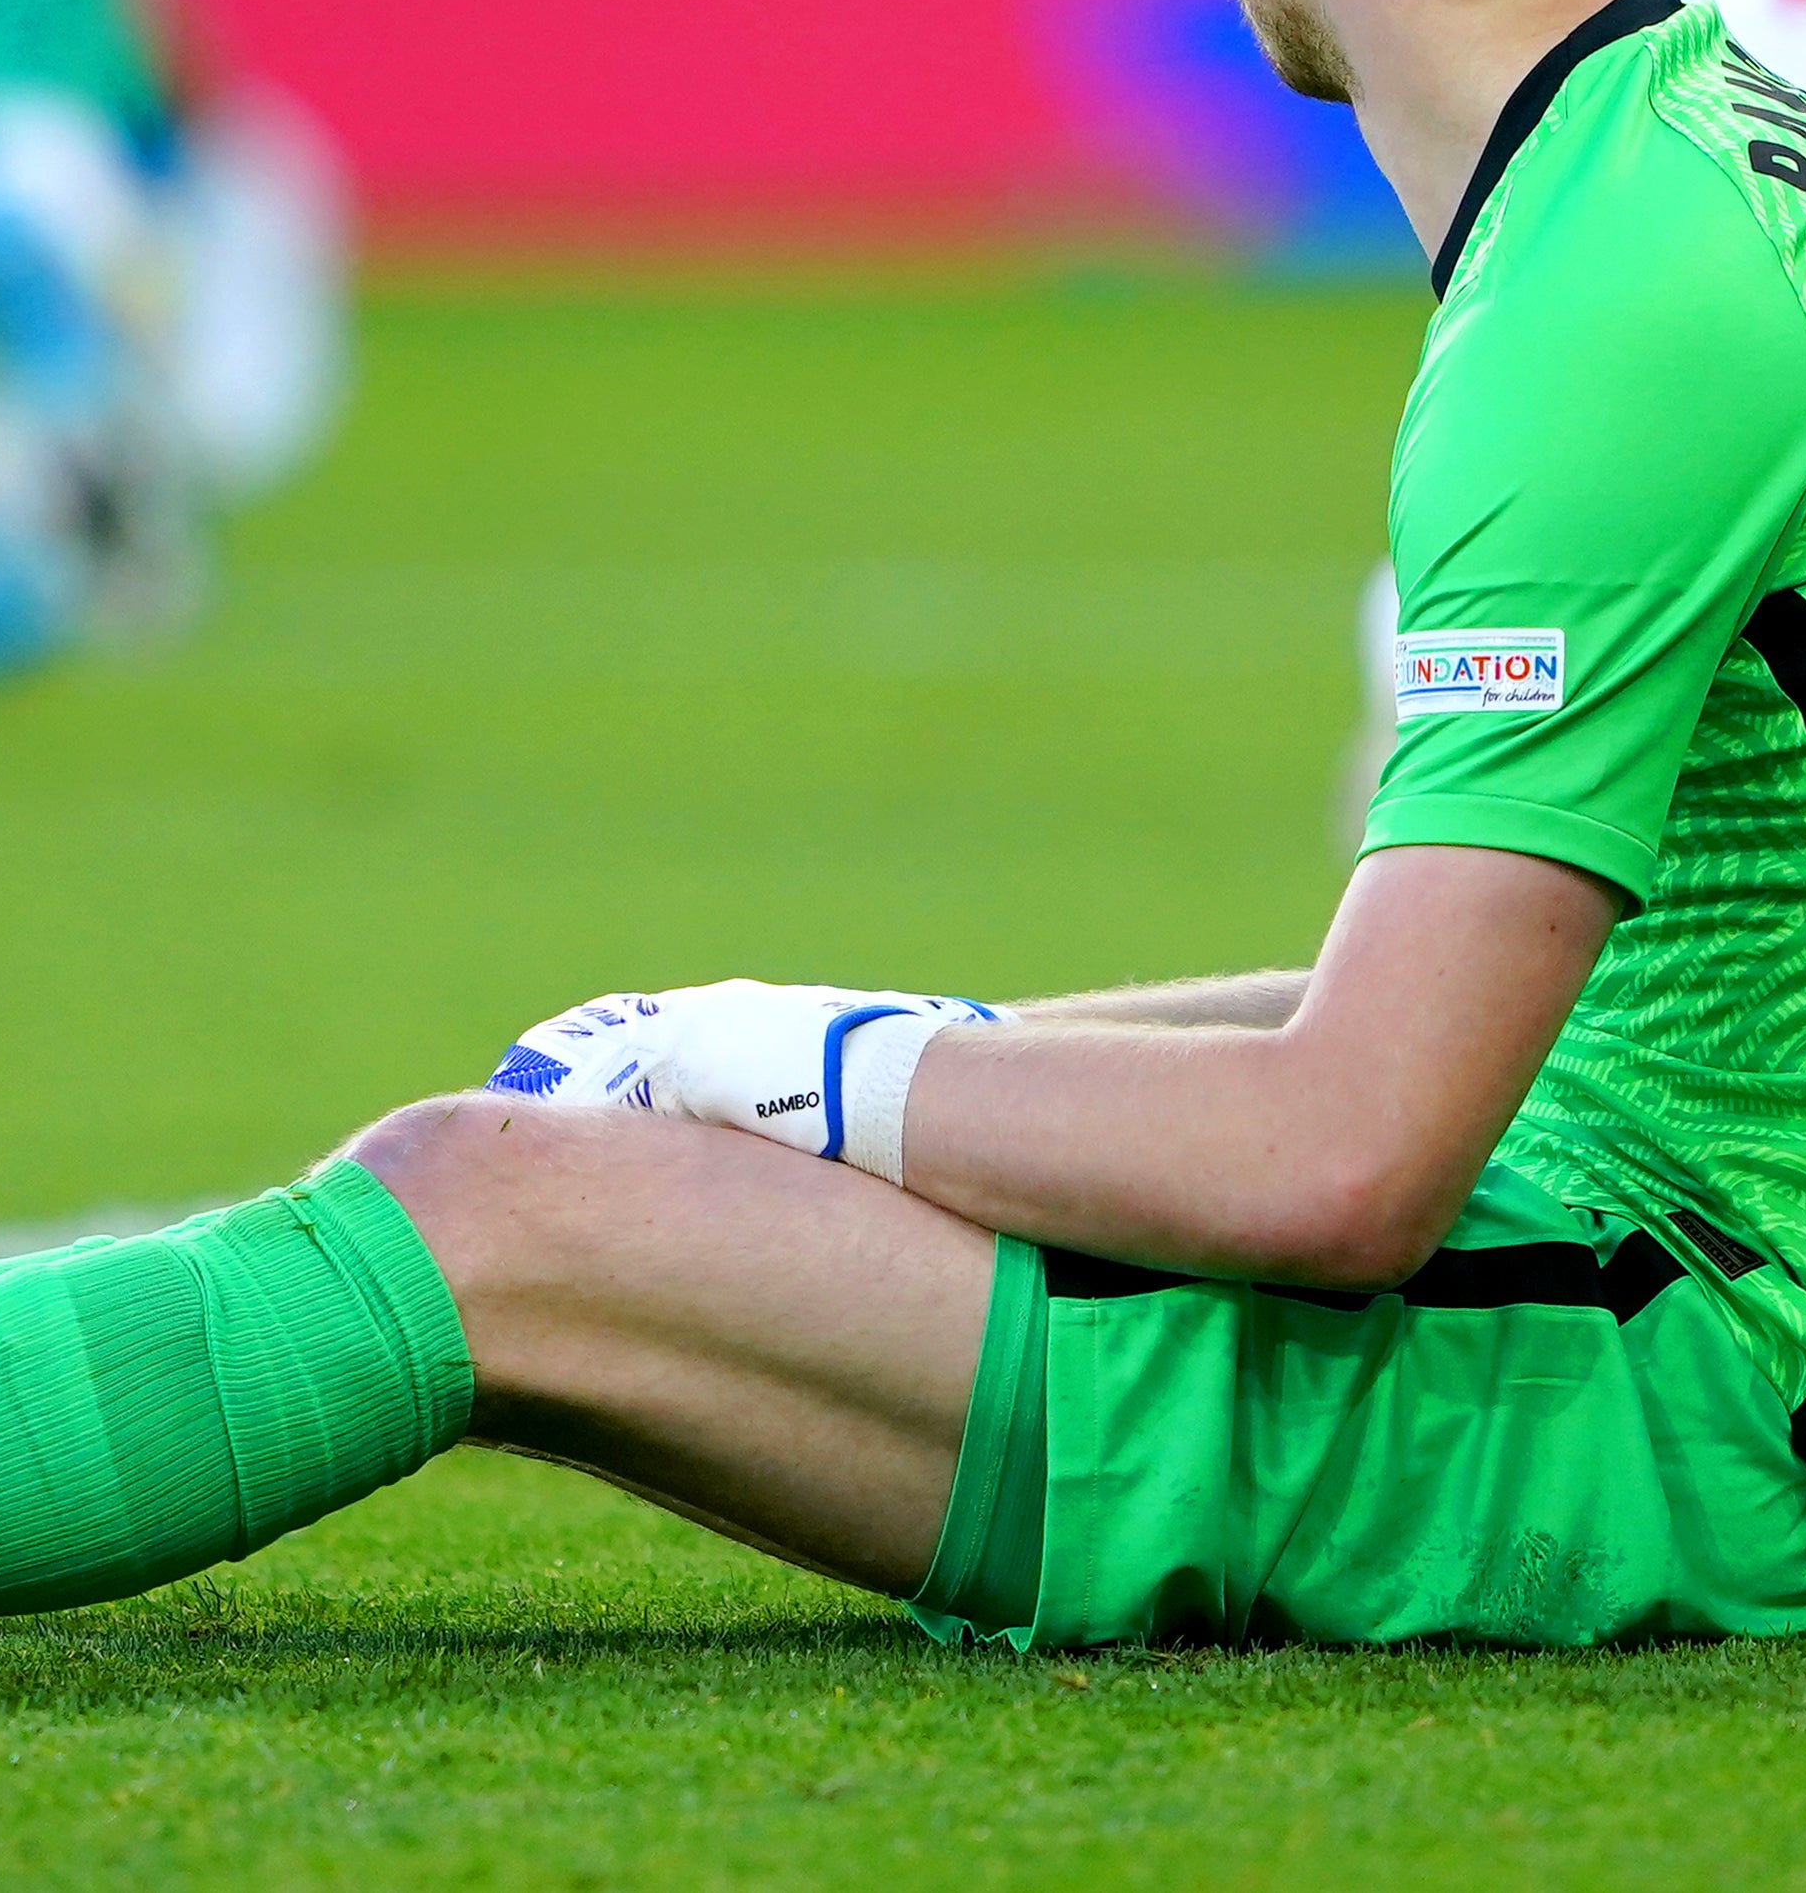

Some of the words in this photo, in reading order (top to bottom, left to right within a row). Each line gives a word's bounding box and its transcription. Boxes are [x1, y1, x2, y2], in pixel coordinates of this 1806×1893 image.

[1482, 687, 1500, 707] for
[1505, 687, 1555, 702] children
[755, 1091, 821, 1119] RAMBO
